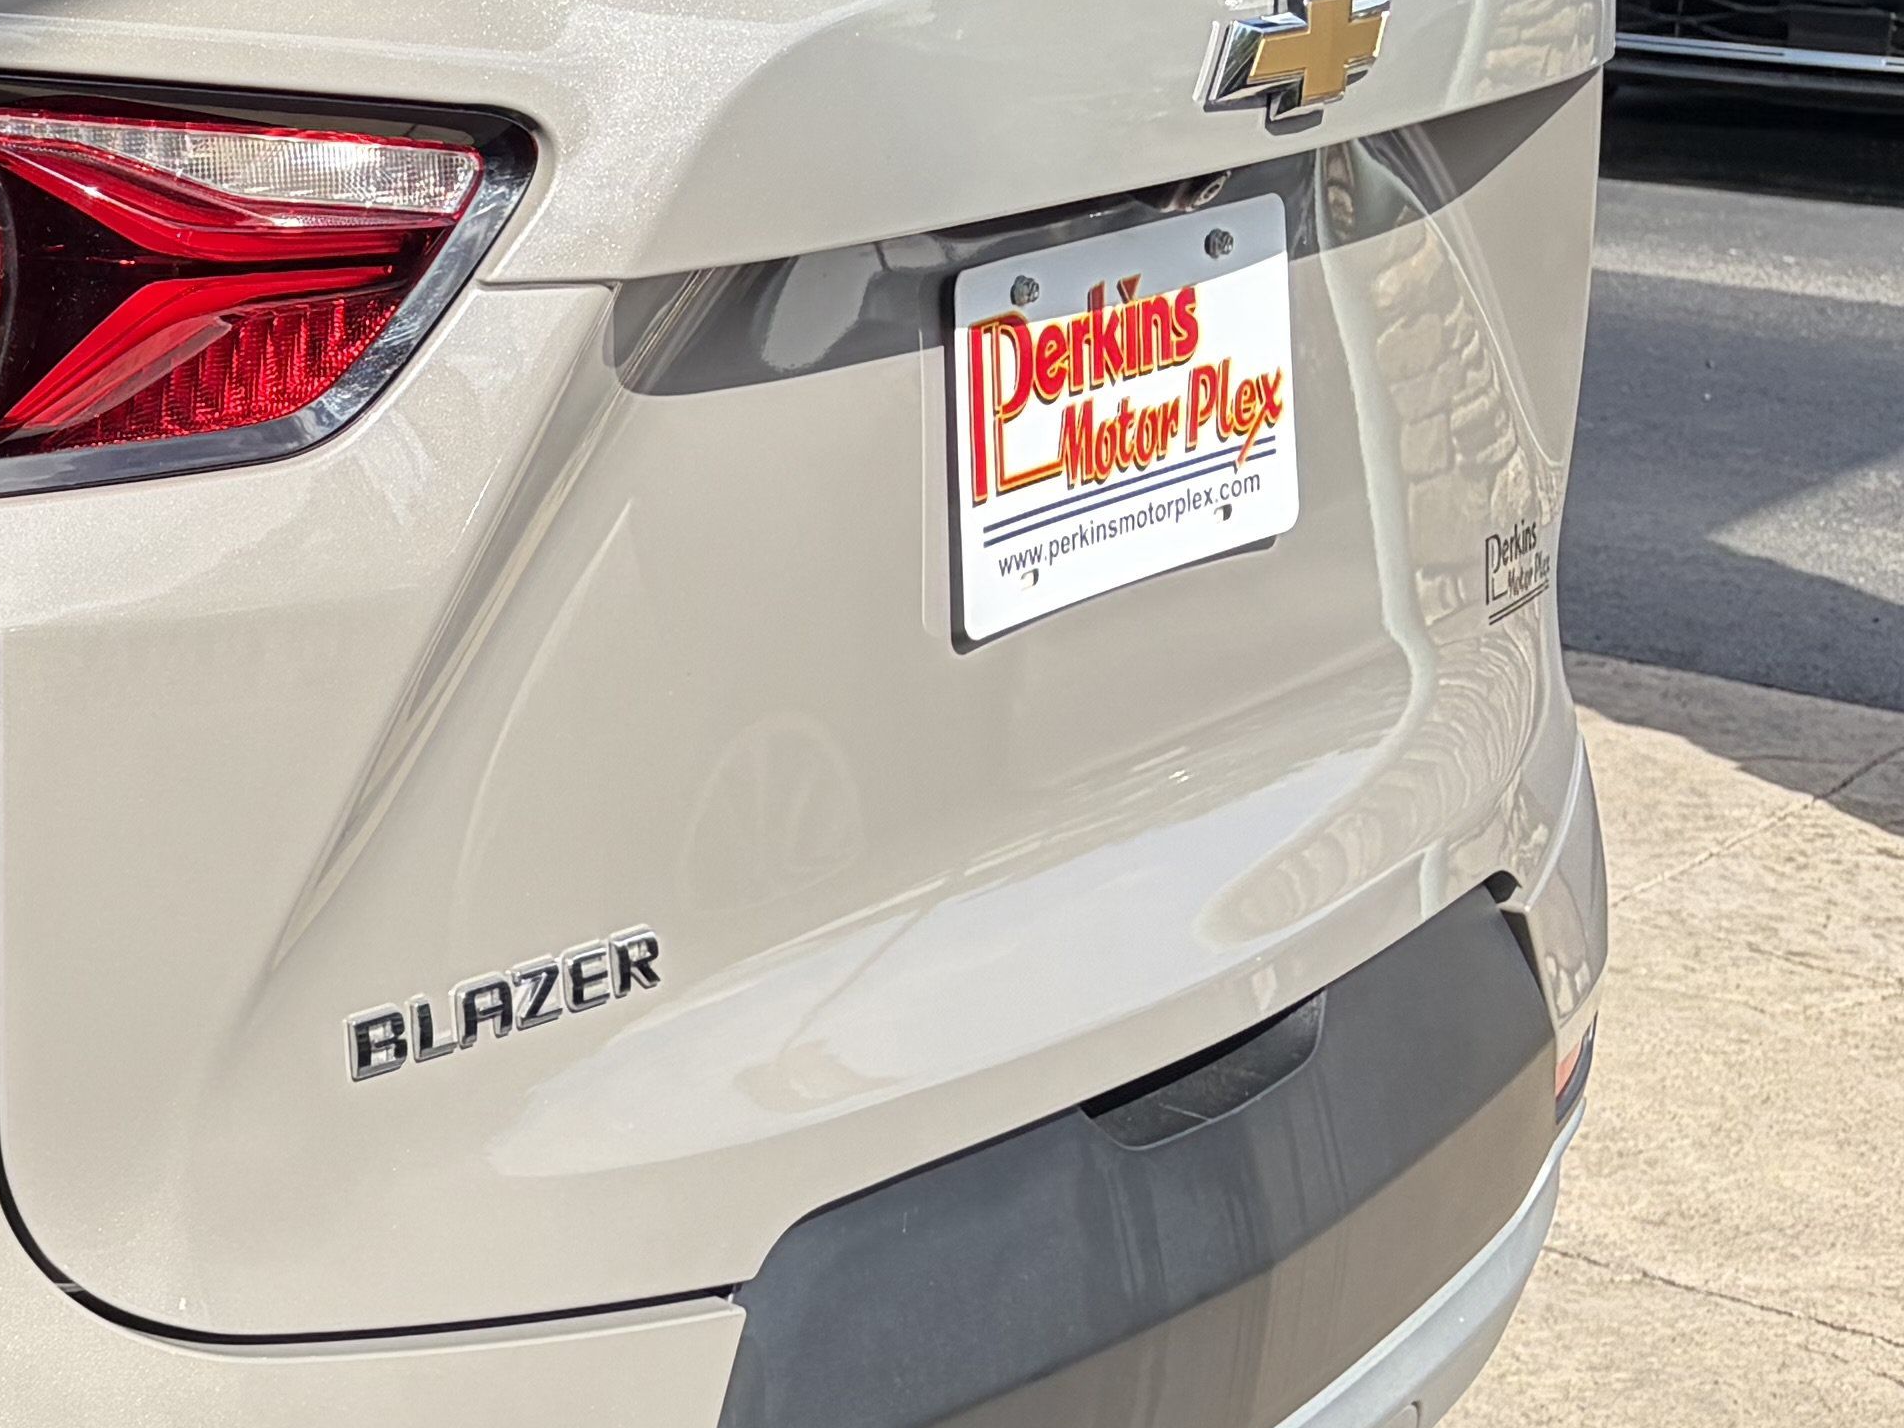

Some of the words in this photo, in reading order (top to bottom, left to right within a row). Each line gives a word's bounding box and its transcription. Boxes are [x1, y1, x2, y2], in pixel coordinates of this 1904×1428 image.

[968, 274, 1201, 509] Perkins
[1058, 394, 1182, 490] Motor
[1186, 357, 1285, 469] Plex
[998, 473, 1262, 577] www.perkinsmotorplex.com
[1485, 518, 1536, 606] Perkins
[342, 922, 662, 1083] BLAZER
